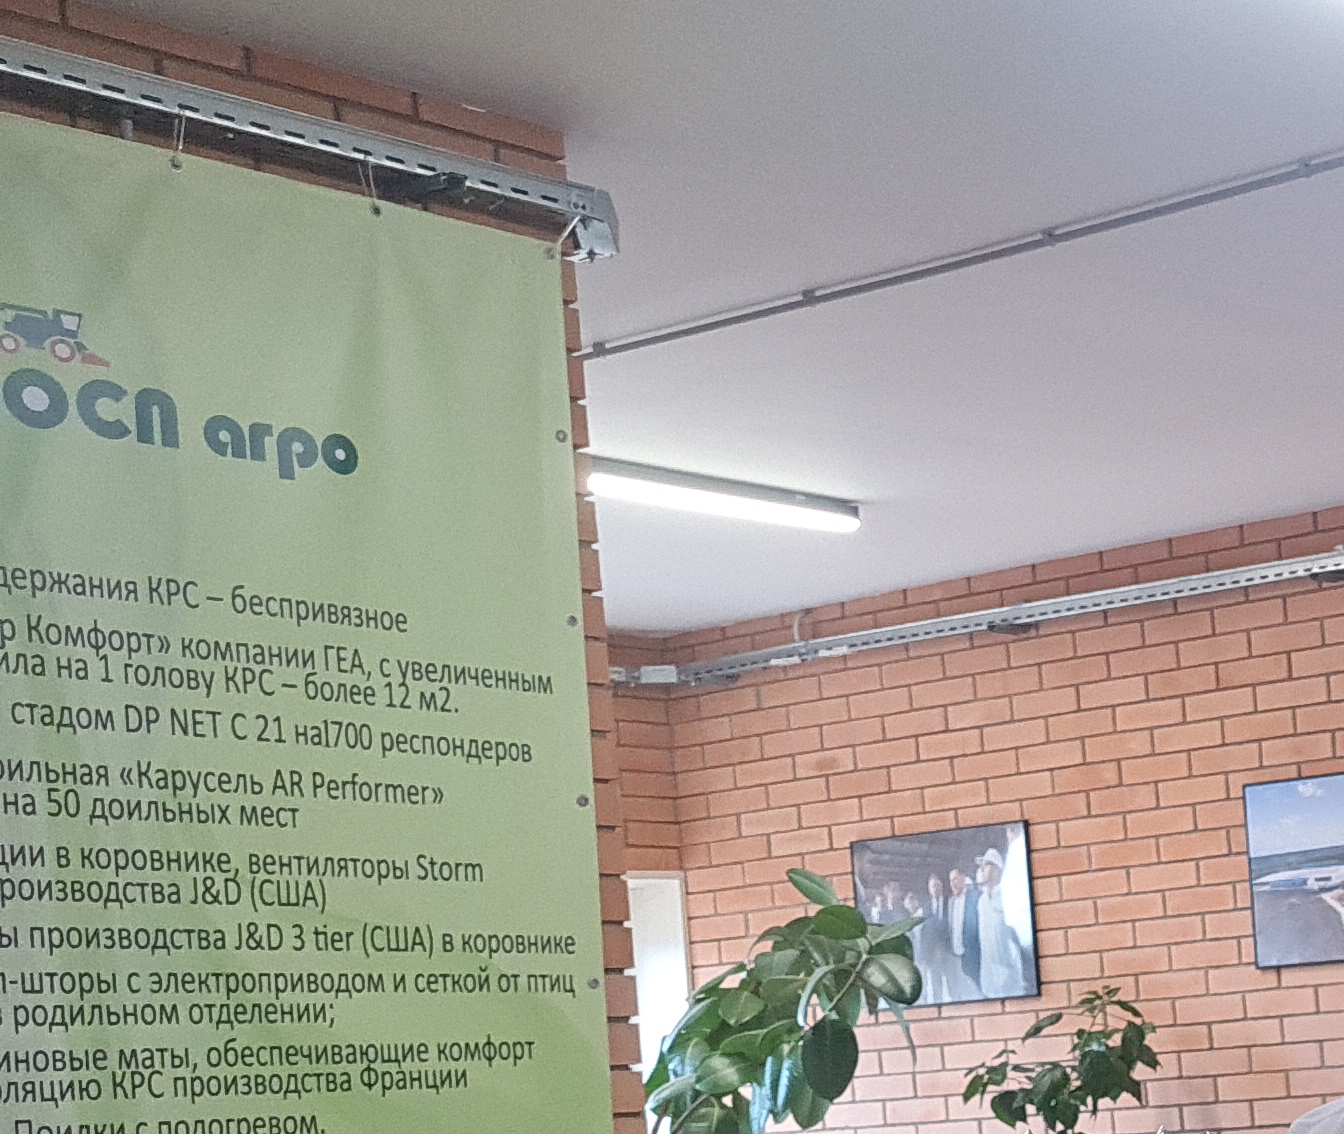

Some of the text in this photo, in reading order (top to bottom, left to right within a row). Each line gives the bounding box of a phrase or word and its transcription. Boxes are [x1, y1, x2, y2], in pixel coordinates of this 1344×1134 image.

[2, 368, 359, 481] ОСП агро
[148, 575, 200, 609] КРС
[231, 584, 408, 633] беспривязное
[26, 613, 554, 695] Комфорт» компании ГЕА, с увеличенным
[56, 653, 459, 714] на 1 голову КРС более 12 м2.
[10, 701, 533, 766] стадом DP NET 21 респондеров
[119, 759, 264, 799] «Карусель
[311, 770, 444, 805] Performer»
[2, 787, 300, 829] на 50 доильных мест
[56, 845, 484, 885] в коровнике, вентиляторы Storm
[190, 875, 242, 906] J&D
[250, 876, 327, 914] (США)
[29, 921, 577, 960] производства J&D 3 tier (США) в коровнике
[126, 965, 576, 1001] с электроприводом и сеткой от птиц
[13, 1001, 336, 1034] родильном отделении;
[118, 1033, 536, 1074] маты, обеспечивающие комфорт
[111, 1063, 469, 1105] КРС производства Франции
